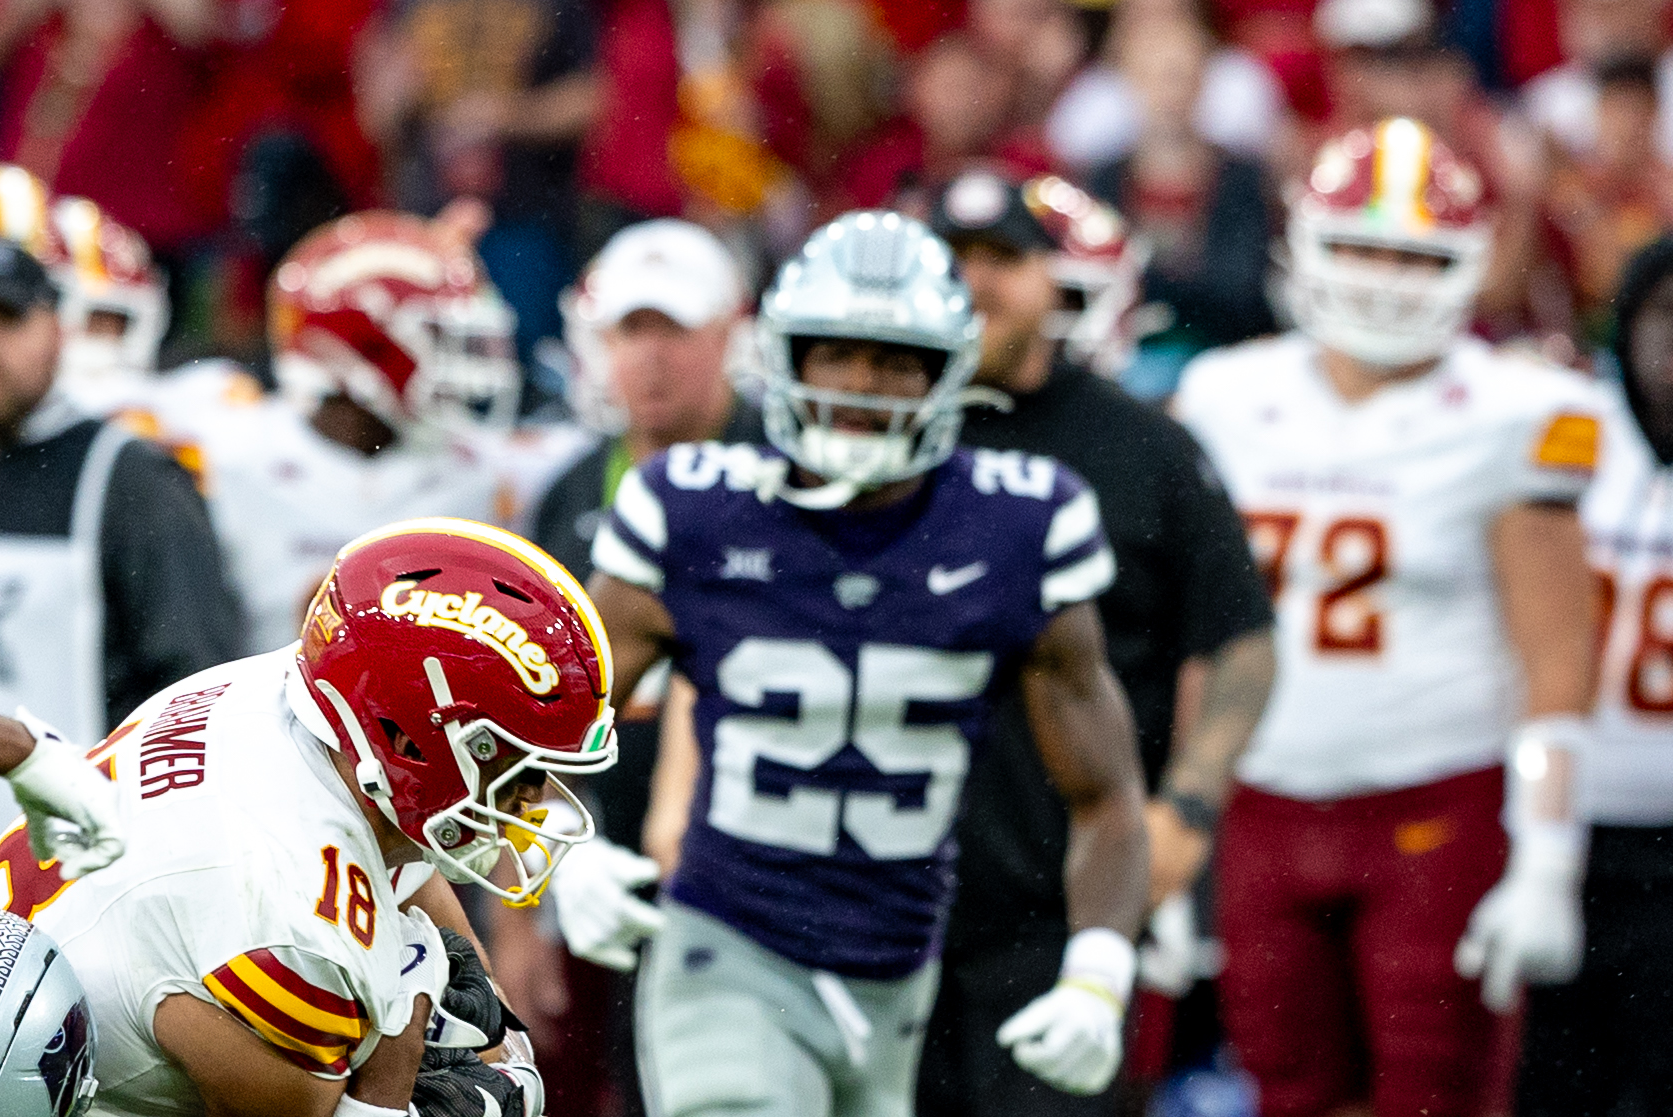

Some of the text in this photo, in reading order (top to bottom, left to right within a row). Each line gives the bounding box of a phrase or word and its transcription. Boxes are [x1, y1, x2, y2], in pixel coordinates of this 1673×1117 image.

[380, 580, 559, 695] Cyclones
[1239, 508, 1389, 656] 72
[706, 636, 994, 861] 25
[314, 844, 376, 950] 18
